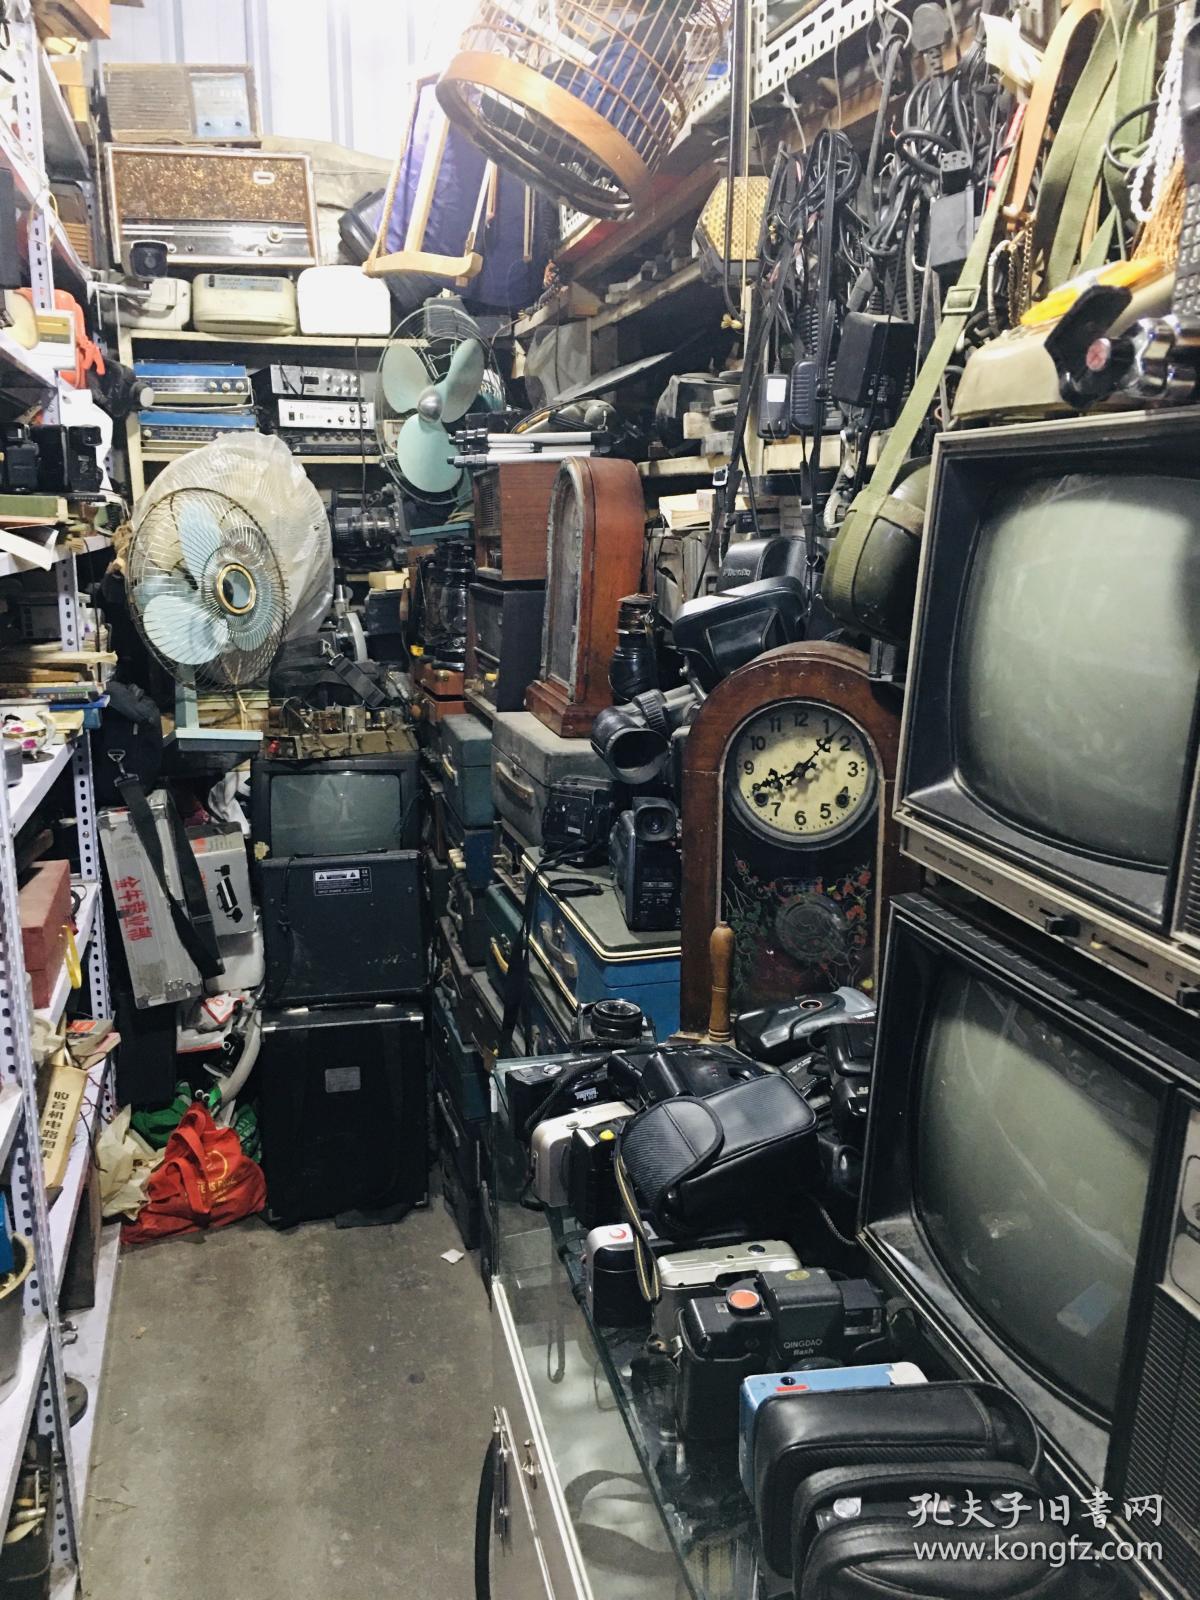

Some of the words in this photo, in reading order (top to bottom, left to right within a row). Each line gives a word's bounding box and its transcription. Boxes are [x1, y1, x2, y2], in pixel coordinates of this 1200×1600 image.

[769, 717, 781, 732] 11
[794, 712, 809, 727] 12
[750, 735, 766, 751] 10
[839, 735, 850, 751] 2
[743, 760, 755, 776] 9
[847, 761, 859, 777] 3
[770, 802, 782, 817] 7
[819, 803, 832, 819] 5
[794, 811, 807, 826] 6
